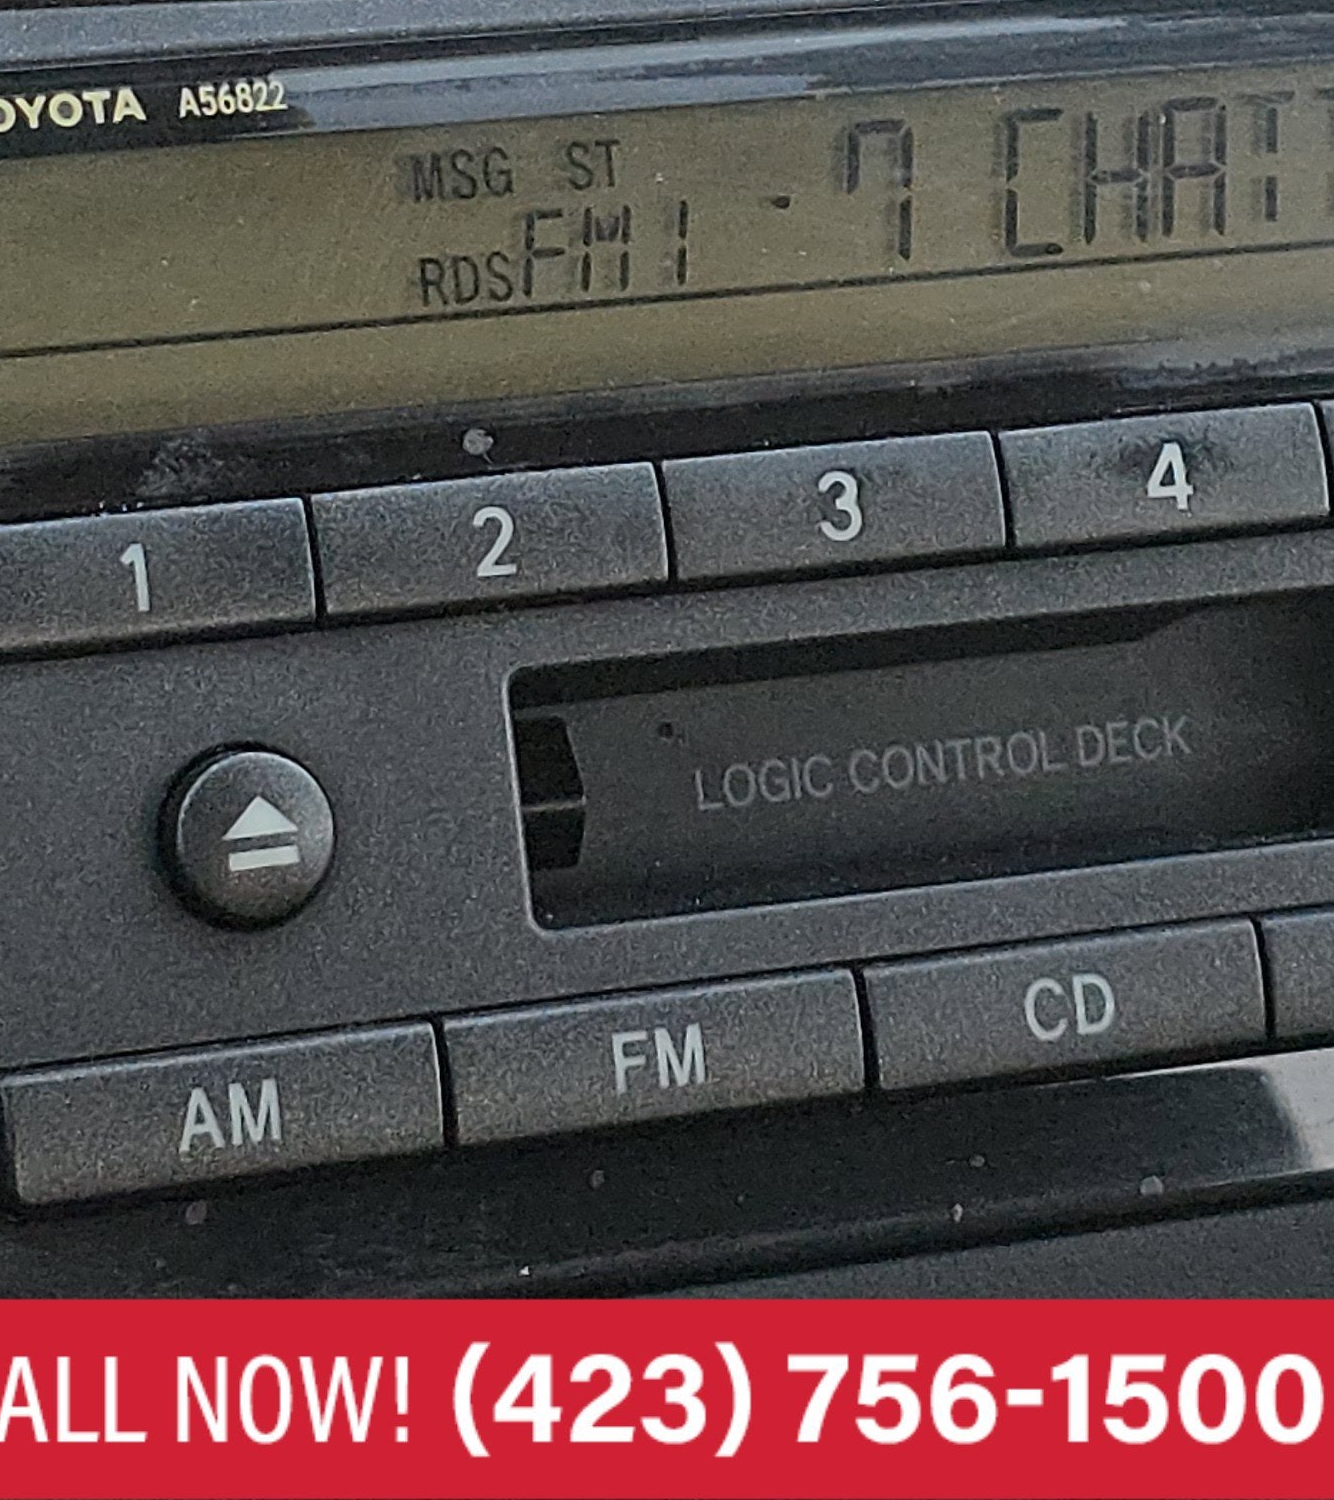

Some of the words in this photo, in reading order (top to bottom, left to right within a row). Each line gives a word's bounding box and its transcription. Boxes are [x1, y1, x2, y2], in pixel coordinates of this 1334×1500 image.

[178, 80, 288, 119] A56822
[412, 146, 514, 202] MSG
[566, 139, 620, 191] ST
[418, 250, 514, 307] RDS
[817, 470, 862, 541] 3
[1146, 442, 1194, 510] 4
[472, 505, 517, 577] 2
[119, 542, 151, 613] 1
[694, 749, 835, 812] LOGIC
[849, 728, 1063, 793] CONTROL
[1076, 716, 1194, 766] DECK
[1022, 972, 1116, 1043] CD
[610, 1024, 707, 1094] FM
[178, 1078, 282, 1152] AM
